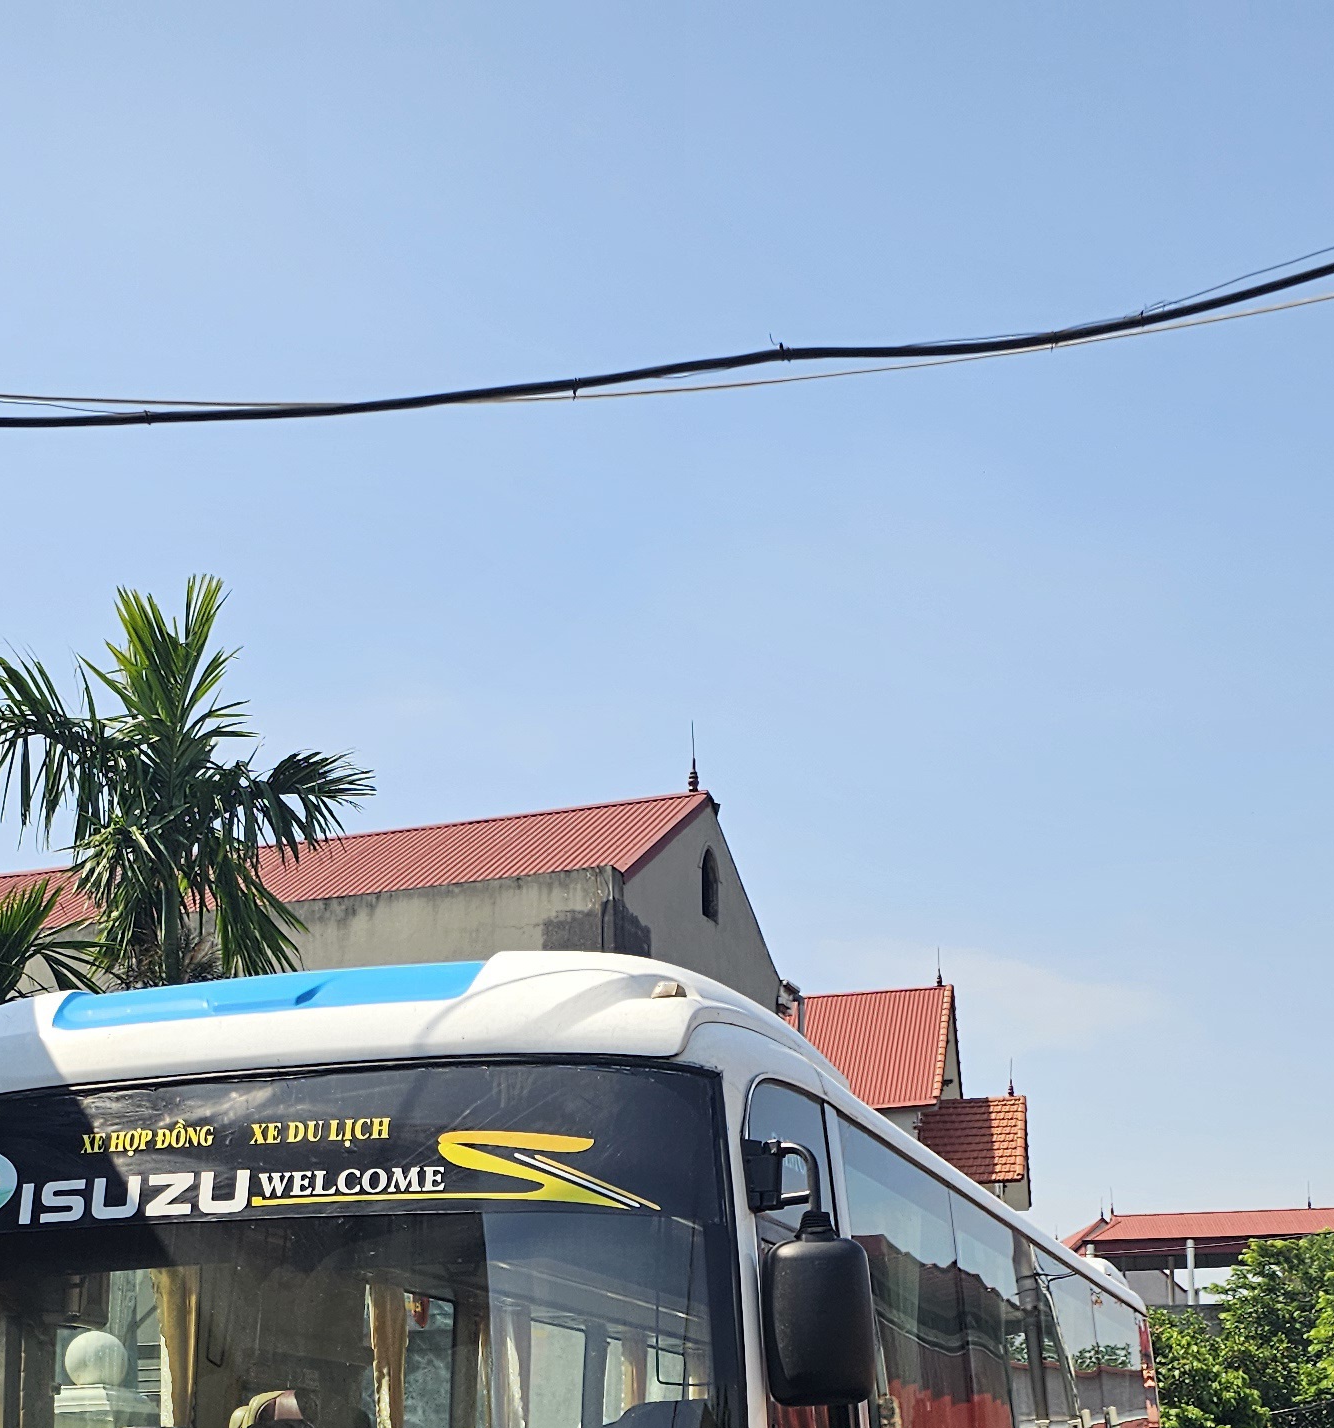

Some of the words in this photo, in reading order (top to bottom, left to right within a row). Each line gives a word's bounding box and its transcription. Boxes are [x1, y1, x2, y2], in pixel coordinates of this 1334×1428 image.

[81, 1133, 105, 1154] XE
[109, 1127, 153, 1156] HỢP
[155, 1119, 215, 1150] ĐỒNG
[250, 1122, 282, 1145] XE
[286, 1120, 325, 1143] DU
[329, 1117, 391, 1147] LỊCH
[18, 1169, 251, 1225] ISUZU
[258, 1166, 445, 1198] WELCOME
